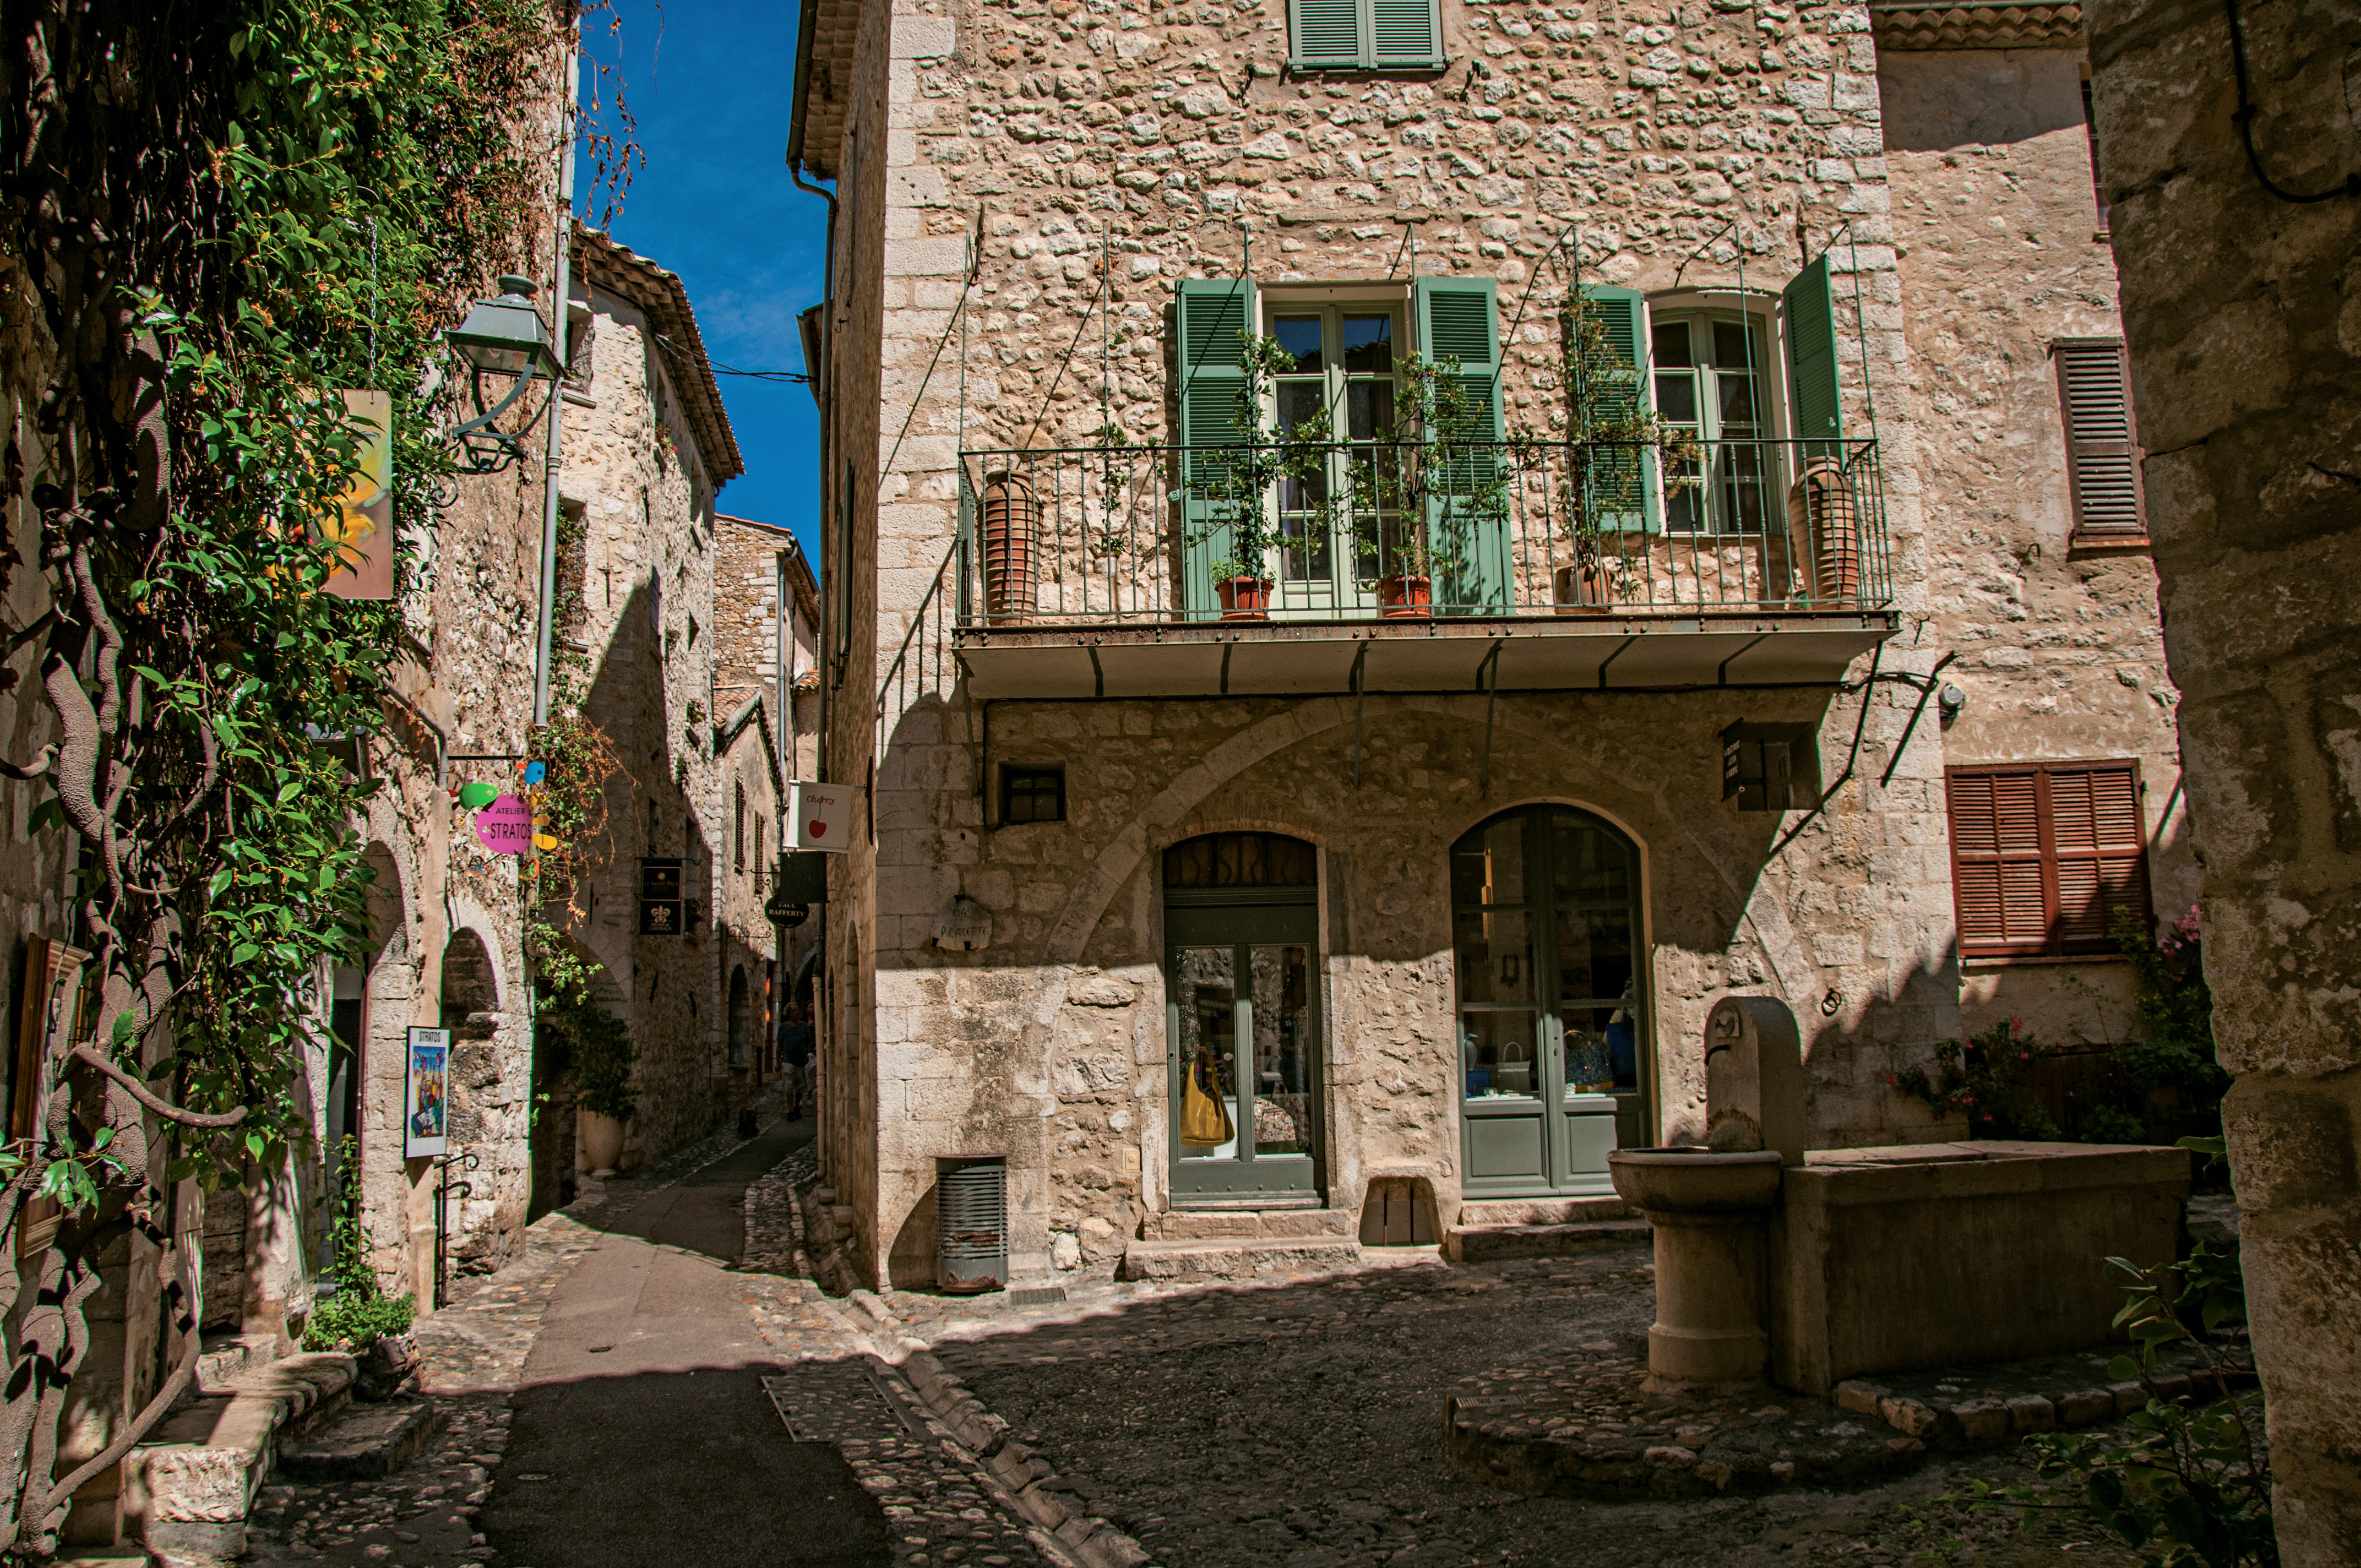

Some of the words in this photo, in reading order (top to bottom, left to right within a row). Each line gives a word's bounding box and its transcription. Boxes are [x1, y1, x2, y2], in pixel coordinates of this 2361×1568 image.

[806, 794, 835, 805] Cherry
[490, 823, 532, 840] STRATOS
[769, 909, 805, 917] RAFFERTY
[419, 1031, 440, 1043] STRATOS
